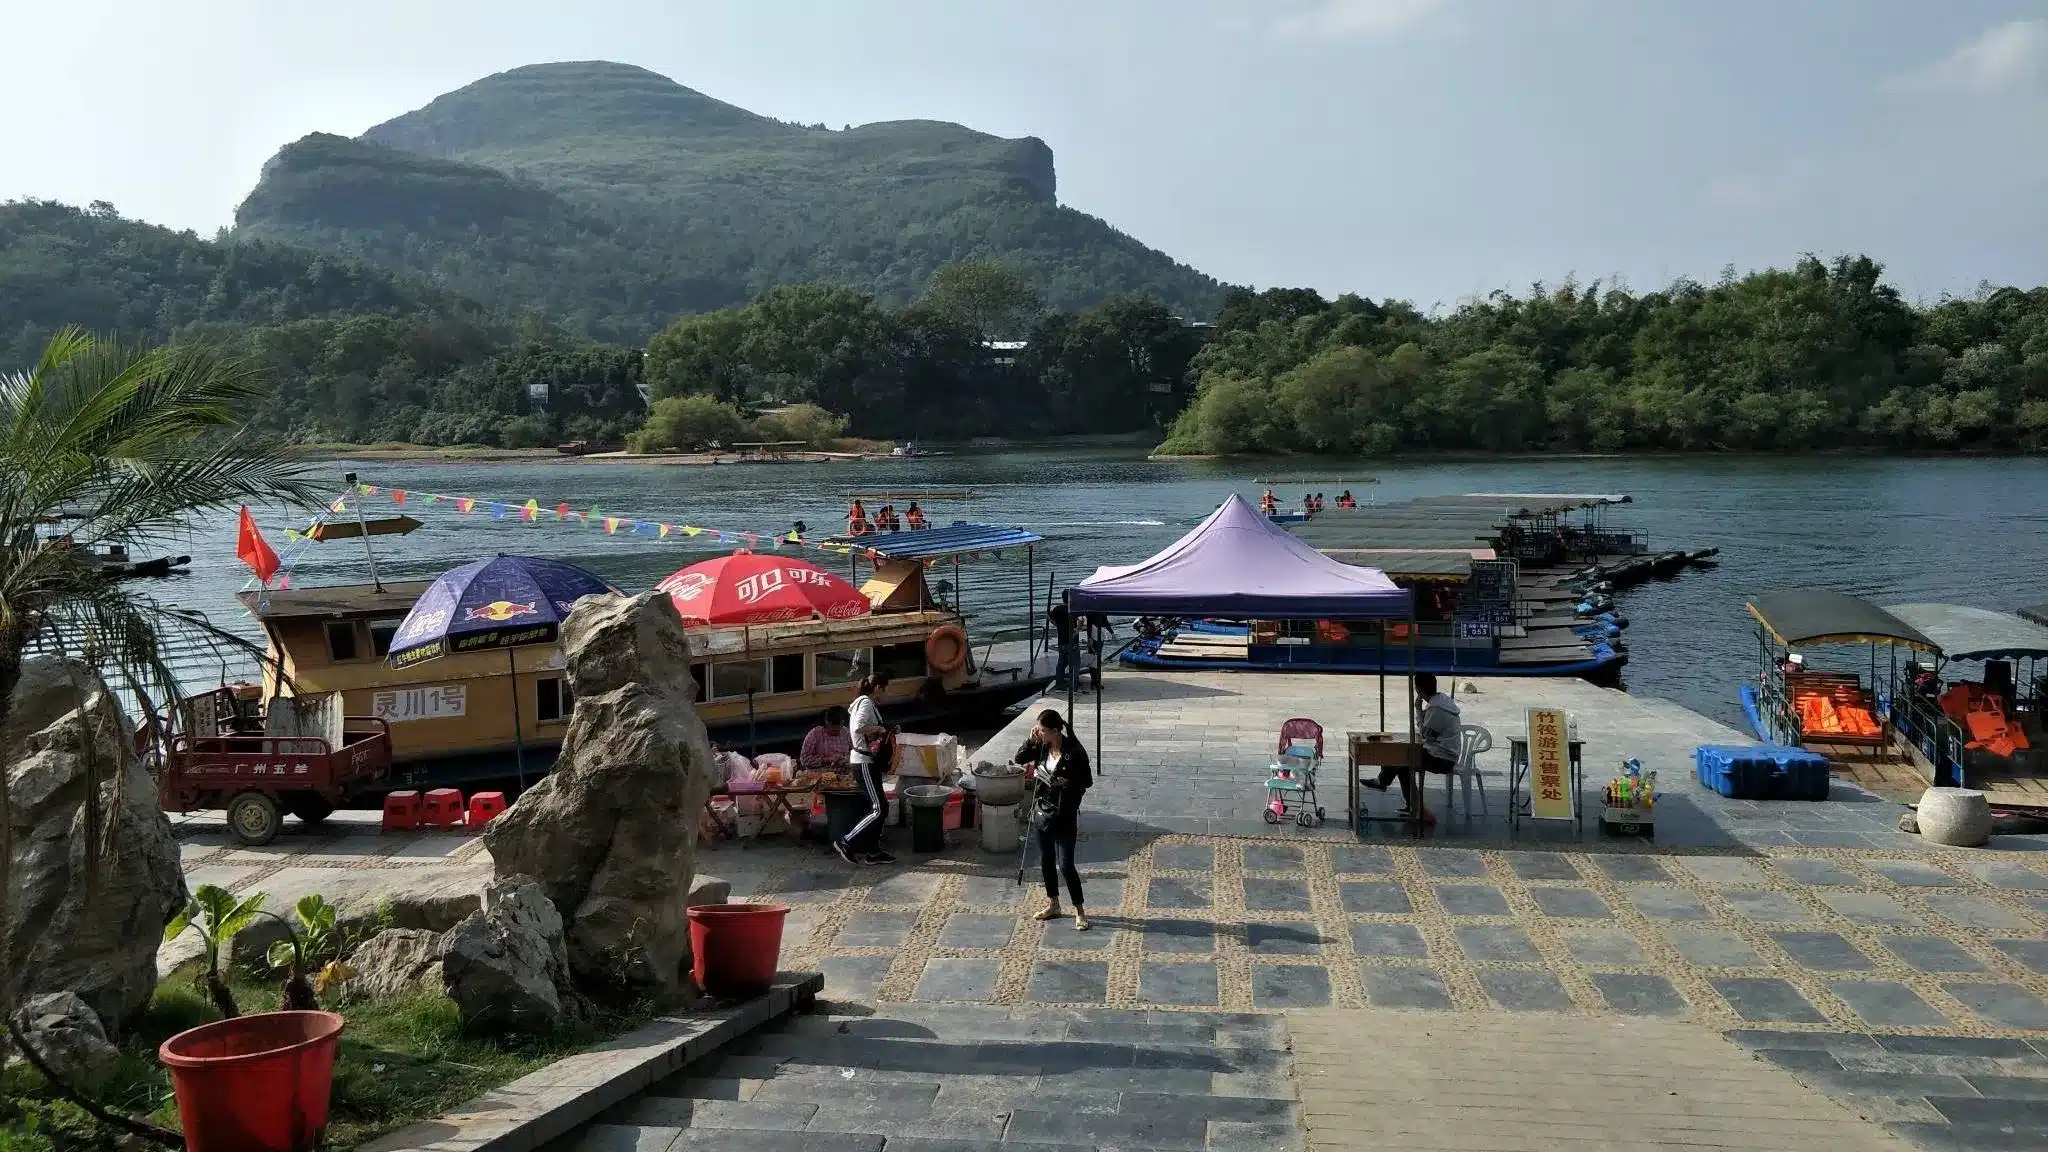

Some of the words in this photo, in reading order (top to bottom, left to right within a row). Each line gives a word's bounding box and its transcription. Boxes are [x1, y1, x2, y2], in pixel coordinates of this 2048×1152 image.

[735, 567, 832, 604] 可口可乐
[376, 686, 465, 719] 灵川1号
[234, 762, 310, 775] 广州五羊
